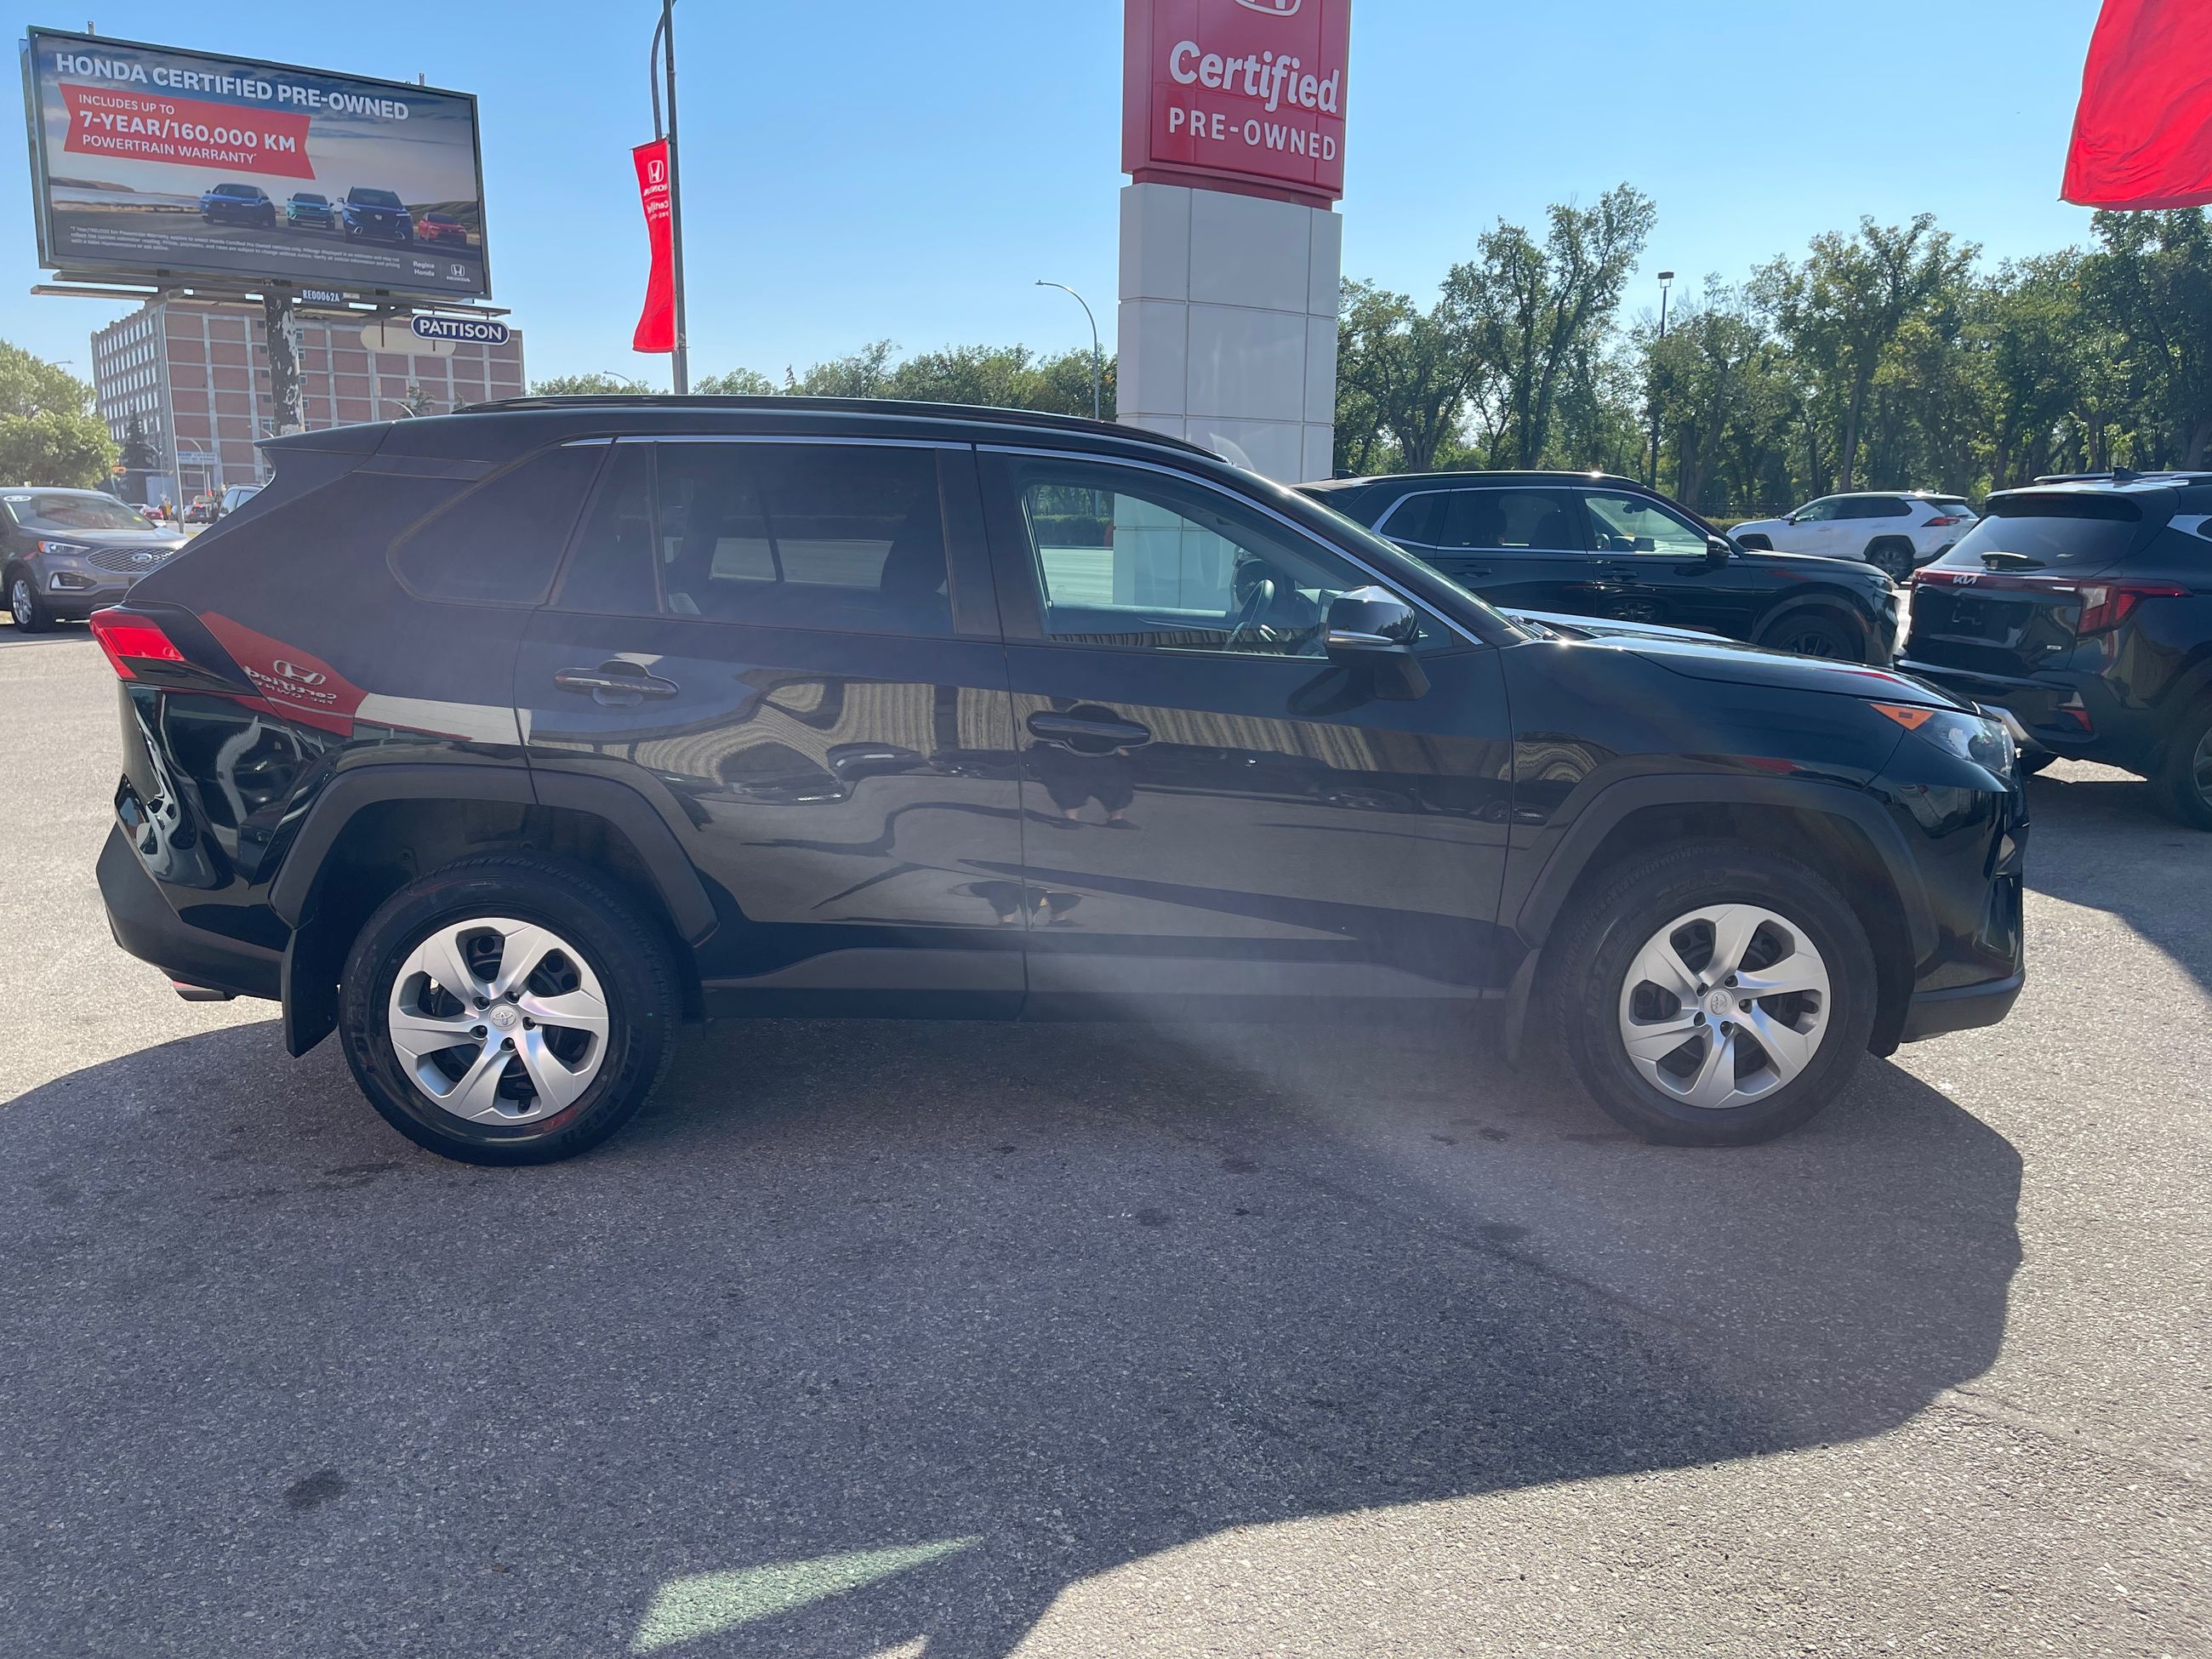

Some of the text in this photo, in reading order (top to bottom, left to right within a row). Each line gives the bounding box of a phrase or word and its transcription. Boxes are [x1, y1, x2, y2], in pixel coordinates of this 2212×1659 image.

[56, 53, 409, 120] HONDA CERTIFIED PRE-OWNED
[1169, 40, 1340, 113] Certified
[79, 94, 175, 115] INCLUDES UP TO
[79, 111, 296, 153] 7-YEAR/160,000 KM
[1169, 106, 1337, 161] PRE-OWNED
[83, 134, 174, 155] POWERTRAIN
[413, 260, 435, 270] Regina
[303, 289, 340, 303] RE00062A
[419, 319, 503, 340] PATTISON
